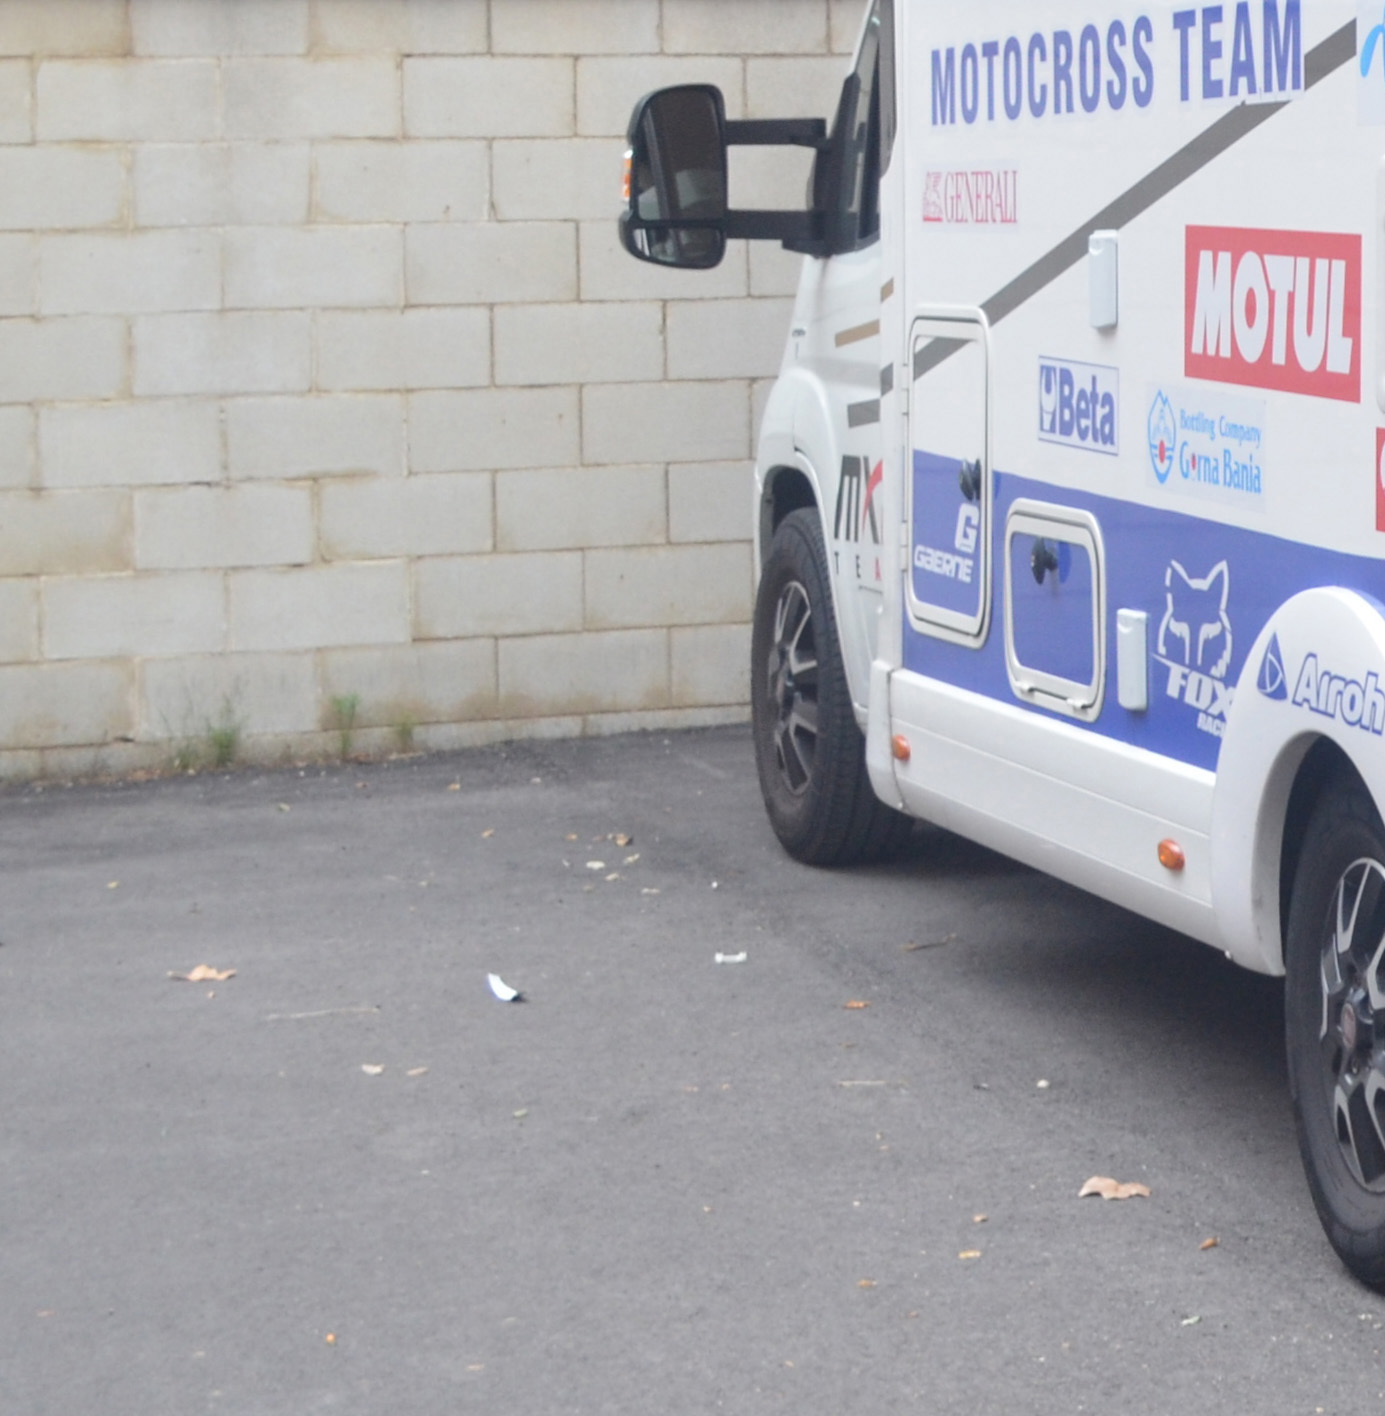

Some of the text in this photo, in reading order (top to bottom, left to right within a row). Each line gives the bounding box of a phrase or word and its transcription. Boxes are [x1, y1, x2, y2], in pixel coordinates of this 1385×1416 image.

[929, 13, 1154, 127] MOTOCROSS
[943, 169, 1018, 225] GENERALI
[1191, 248, 1354, 375] MOTUL
[1057, 366, 1116, 447] Beta
[1222, 447, 1263, 495] Bania
[1160, 656, 1237, 724] FOX
